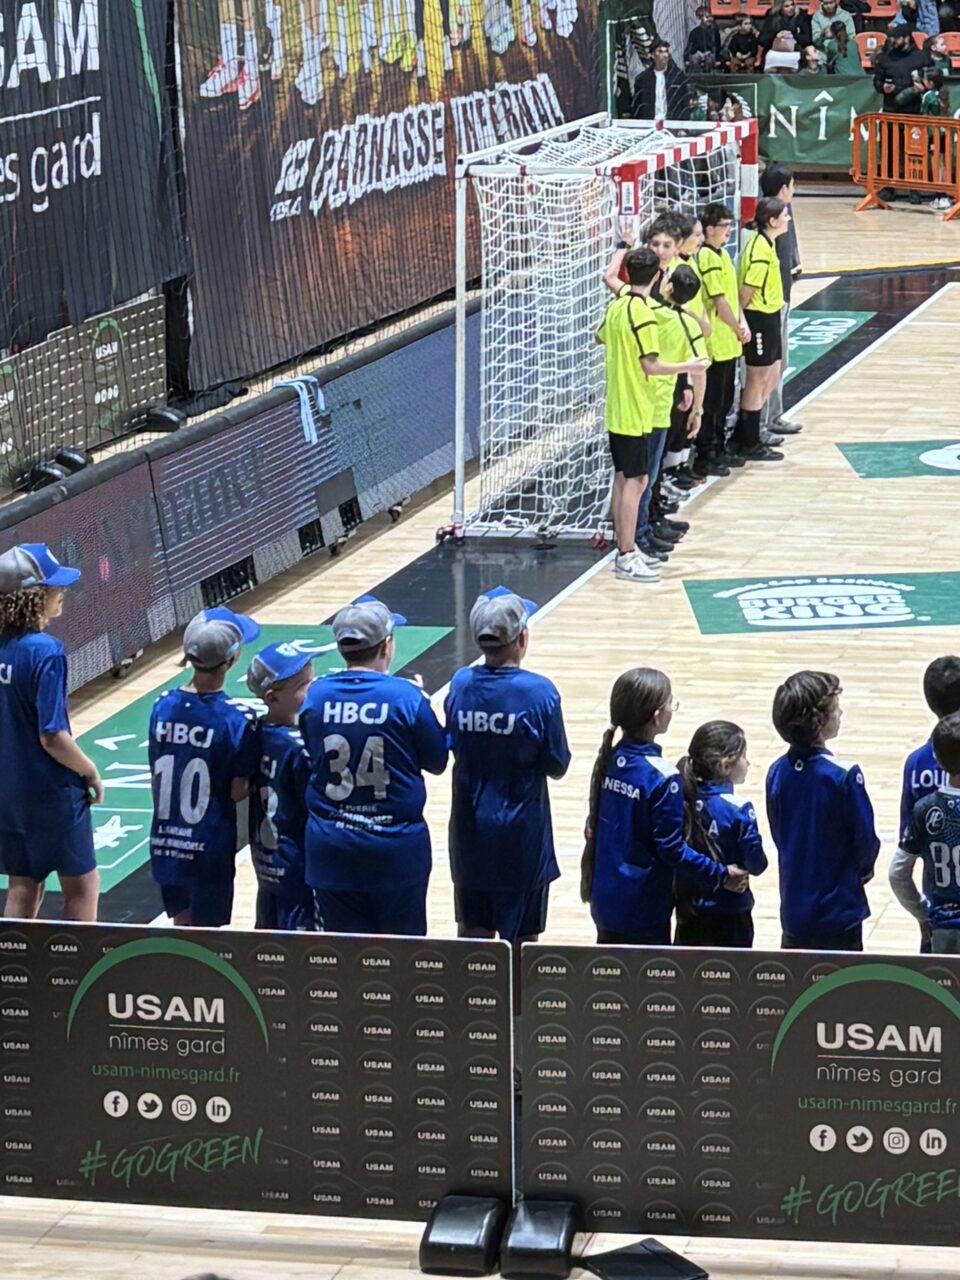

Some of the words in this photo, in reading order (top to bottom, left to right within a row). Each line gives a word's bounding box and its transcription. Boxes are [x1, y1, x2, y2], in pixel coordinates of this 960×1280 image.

[31, 112, 101, 213] gard
[742, 603, 912, 620] KING
[323, 701, 389, 725] HBCJ
[457, 710, 516, 735] HBCJ
[156, 721, 214, 749] HBCJ
[323, 733, 390, 801] 34
[154, 754, 211, 825] 10
[107, 992, 225, 1024] USAM
[109, 1032, 169, 1052] nîmes
[177, 1037, 225, 1056] gard
[816, 1022, 942, 1054] USAM
[92, 1064, 240, 1084] usam-nimesgard.fr
[817, 1062, 881, 1083] nîmes
[890, 1067, 942, 1087] gard
[798, 1096, 957, 1116] usam-nimesgard.fr
[78, 1128, 264, 1188] #GOGREEN
